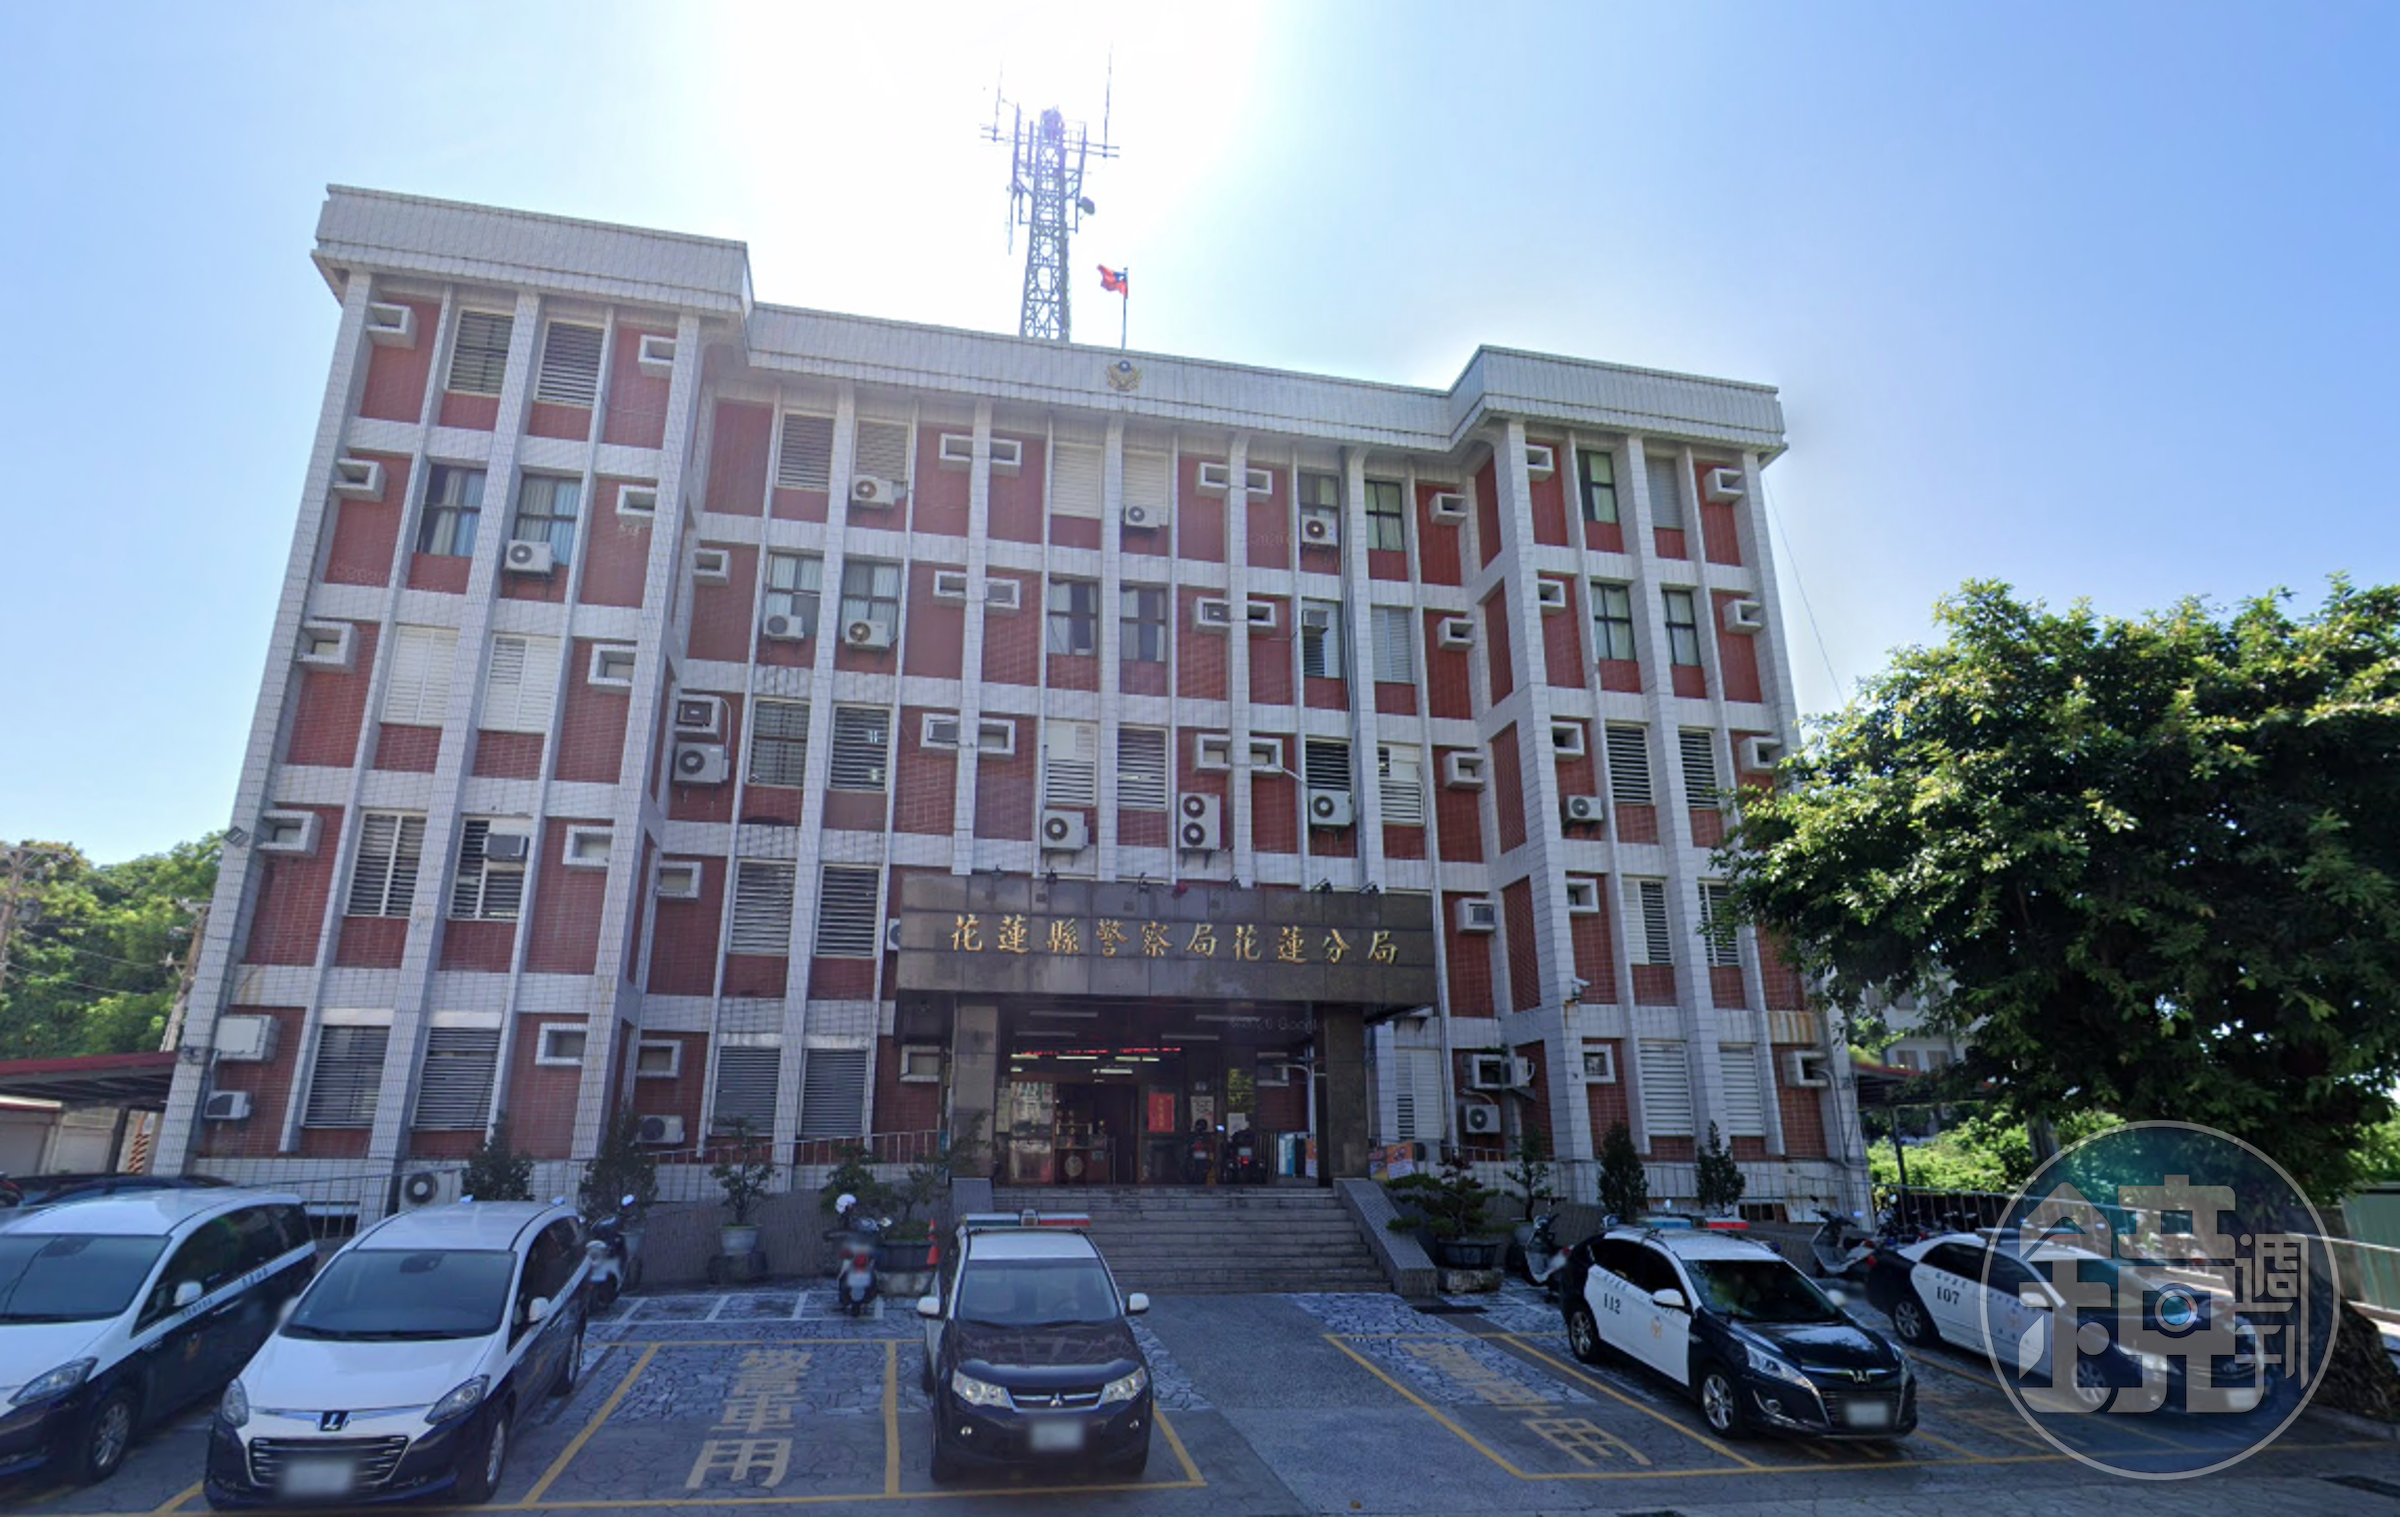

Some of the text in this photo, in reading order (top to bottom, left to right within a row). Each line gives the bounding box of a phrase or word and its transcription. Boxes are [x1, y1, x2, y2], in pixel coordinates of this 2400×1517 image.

[950, 914, 1399, 966] 花蓮縣警察局花蓮分局
[1603, 1292, 1622, 1315] 112
[1936, 1286, 1960, 1305] 107
[685, 1350, 813, 1490] 警車用
[1399, 1341, 1652, 1466] 警車用
